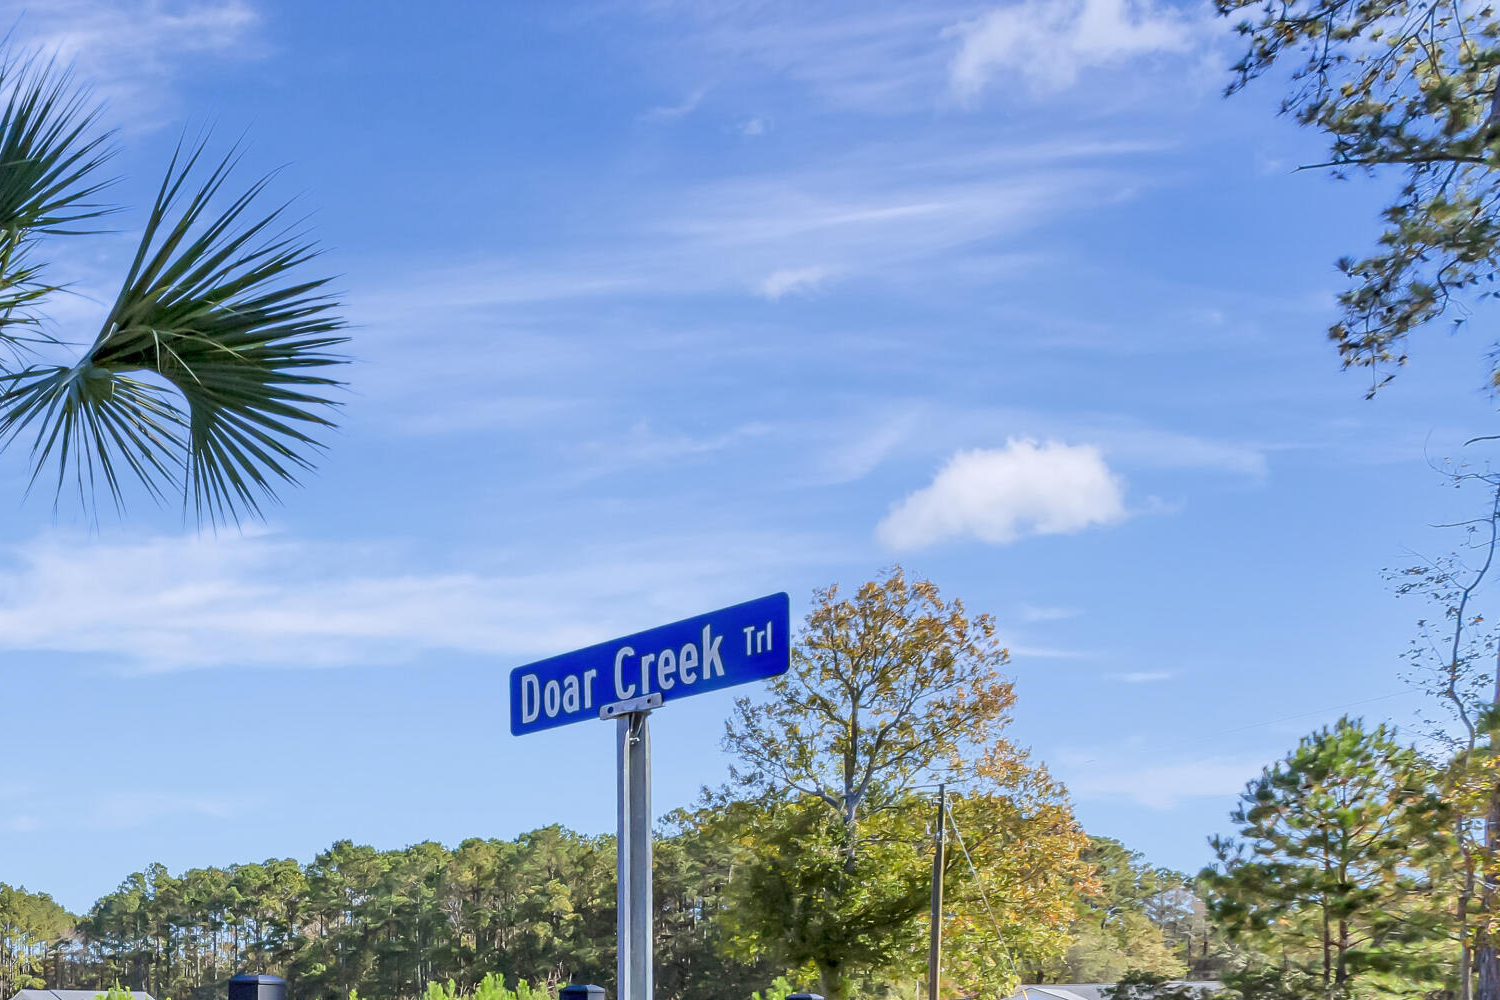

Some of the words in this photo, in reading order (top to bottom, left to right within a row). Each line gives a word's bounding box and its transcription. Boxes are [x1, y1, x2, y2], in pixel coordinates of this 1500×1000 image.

[521, 668, 597, 724] Doar
[614, 623, 725, 700] Creek
[743, 620, 773, 656] Trl
